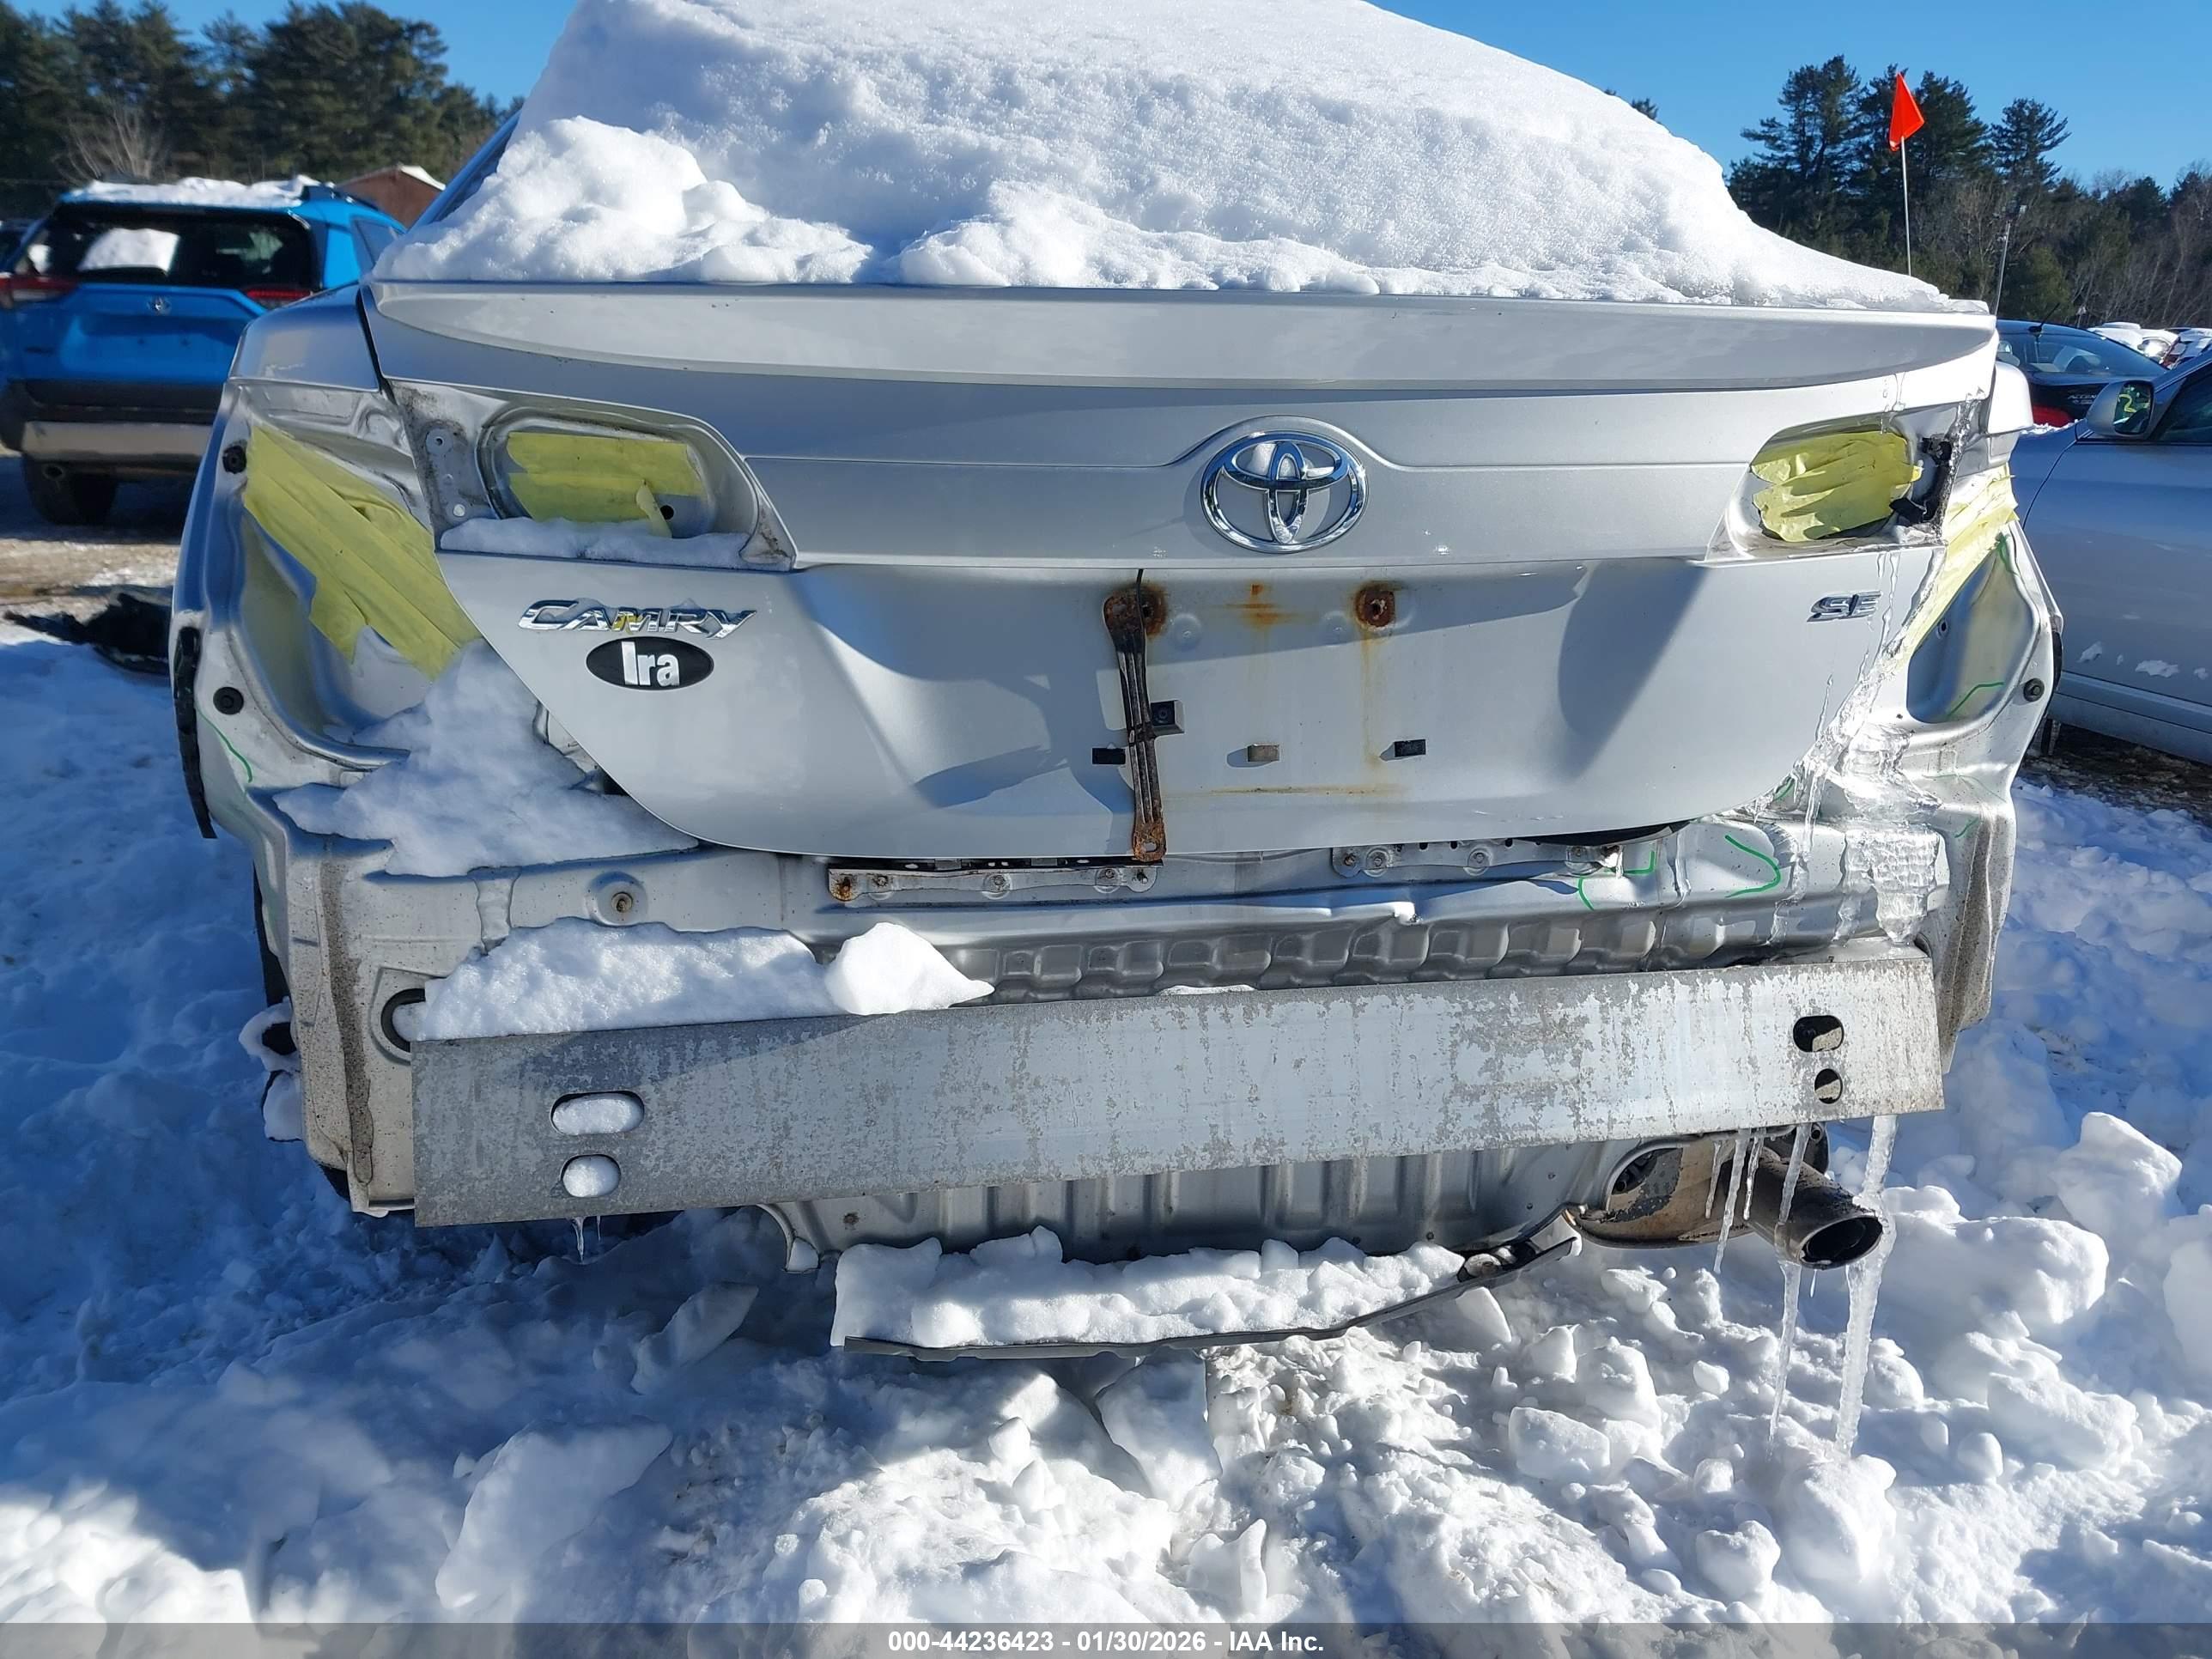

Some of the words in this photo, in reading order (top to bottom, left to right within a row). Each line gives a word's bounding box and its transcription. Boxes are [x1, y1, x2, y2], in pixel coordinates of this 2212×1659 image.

[518, 599, 757, 639] CAMRY
[1807, 591, 1881, 622] SE
[621, 641, 680, 687] Ira
